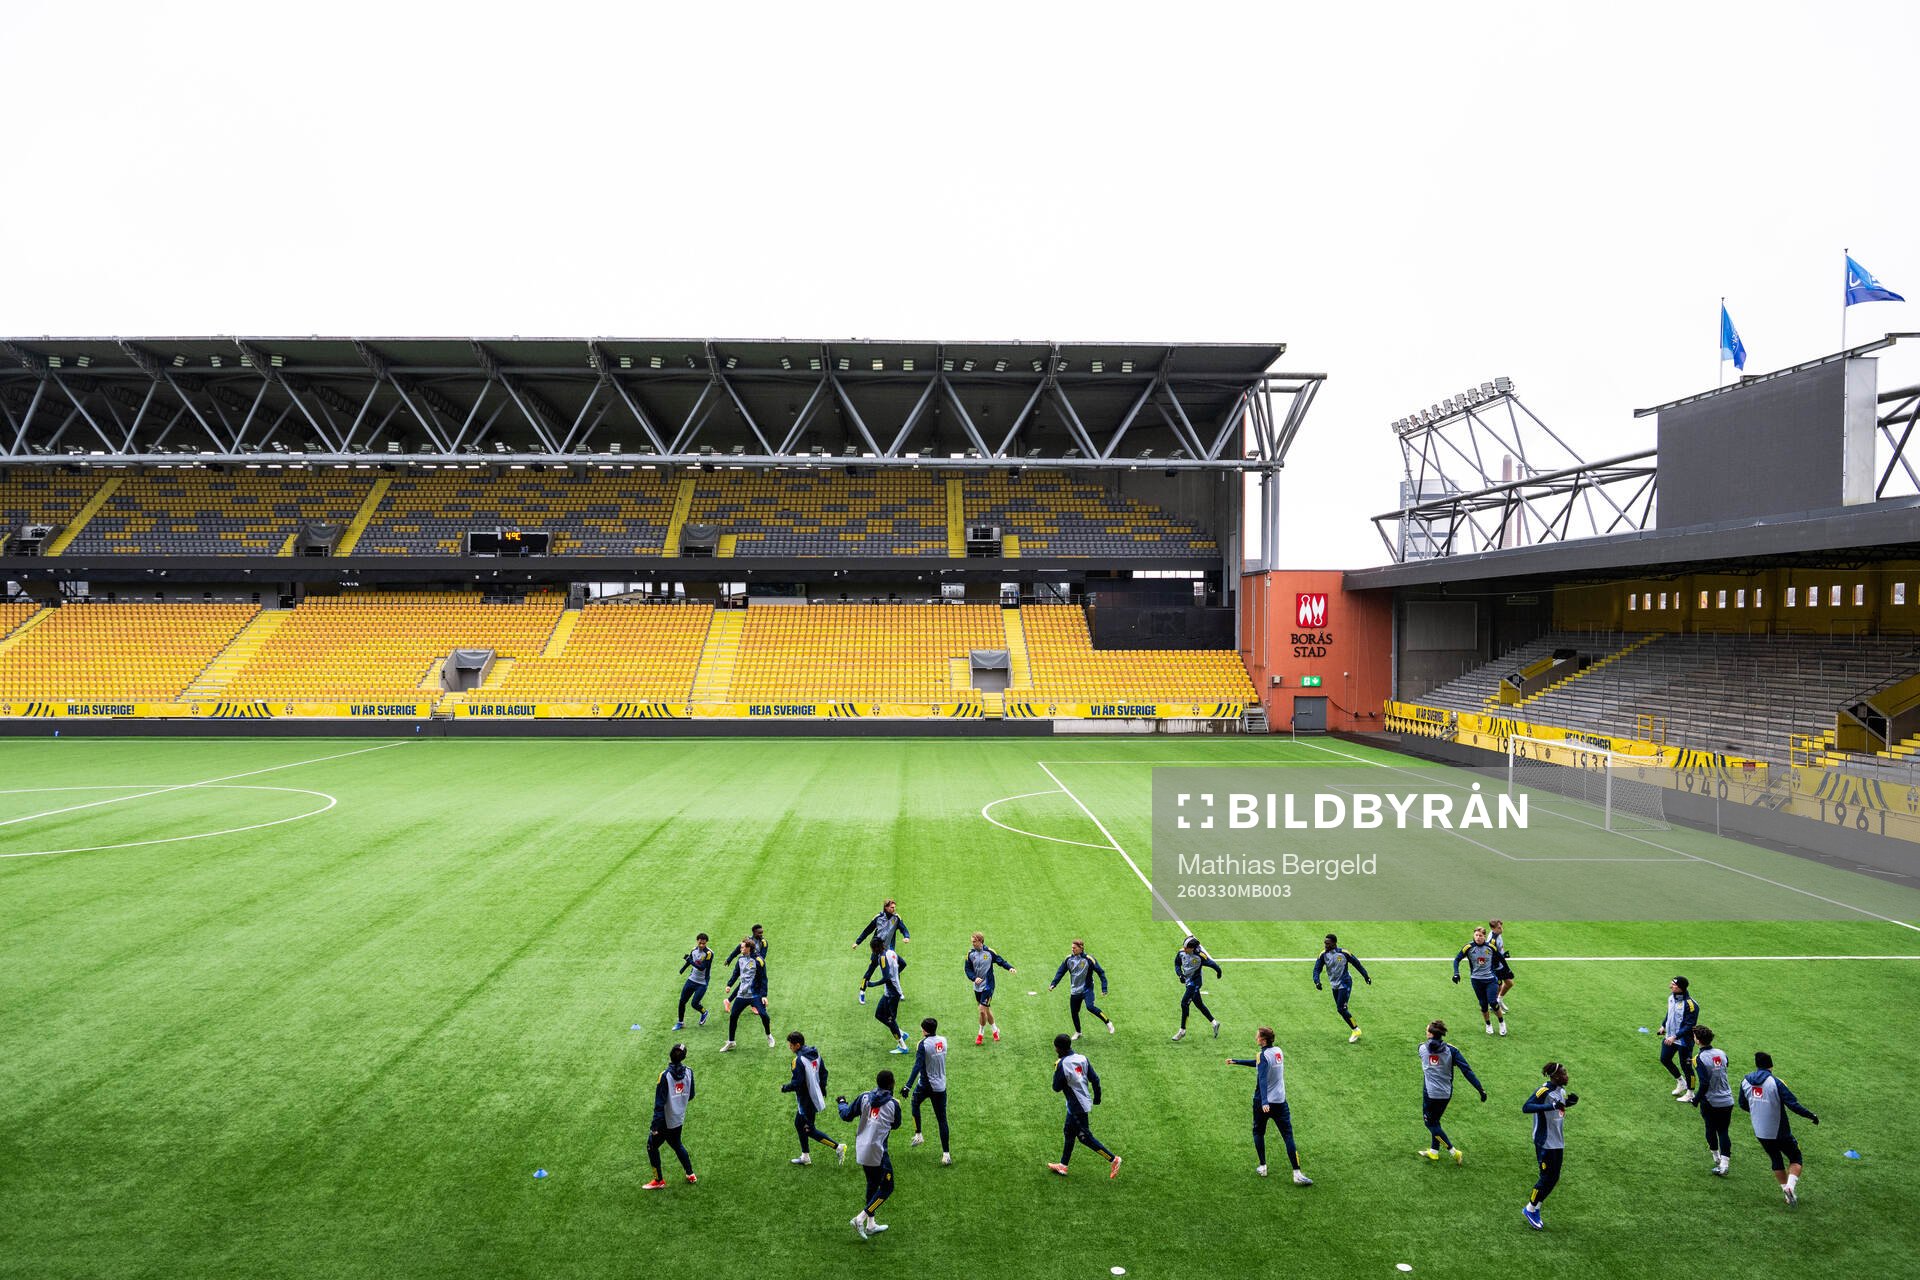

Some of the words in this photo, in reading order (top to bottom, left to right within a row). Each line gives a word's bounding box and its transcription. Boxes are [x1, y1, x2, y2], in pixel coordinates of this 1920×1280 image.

[1291, 631, 1333, 645] BORÅS
[1293, 646, 1327, 658] STAD
[68, 704, 90, 715] HEJA
[92, 704, 135, 715] SVERIGE!
[350, 704, 360, 715] VI
[362, 704, 375, 715] ÄR
[377, 704, 417, 715] SVERIGE
[469, 705, 479, 715] VI
[480, 704, 494, 715] ÄR
[495, 703, 536, 715] BLÅGULT
[749, 705, 772, 715] HEJA
[773, 705, 816, 715] SVERIGE!
[1090, 705, 1100, 715] VI
[1102, 704, 1115, 715] ÄR
[1117, 705, 1156, 715] SVERIGE
[1675, 771, 1728, 800] 1940
[1819, 799, 1886, 836] 1961
